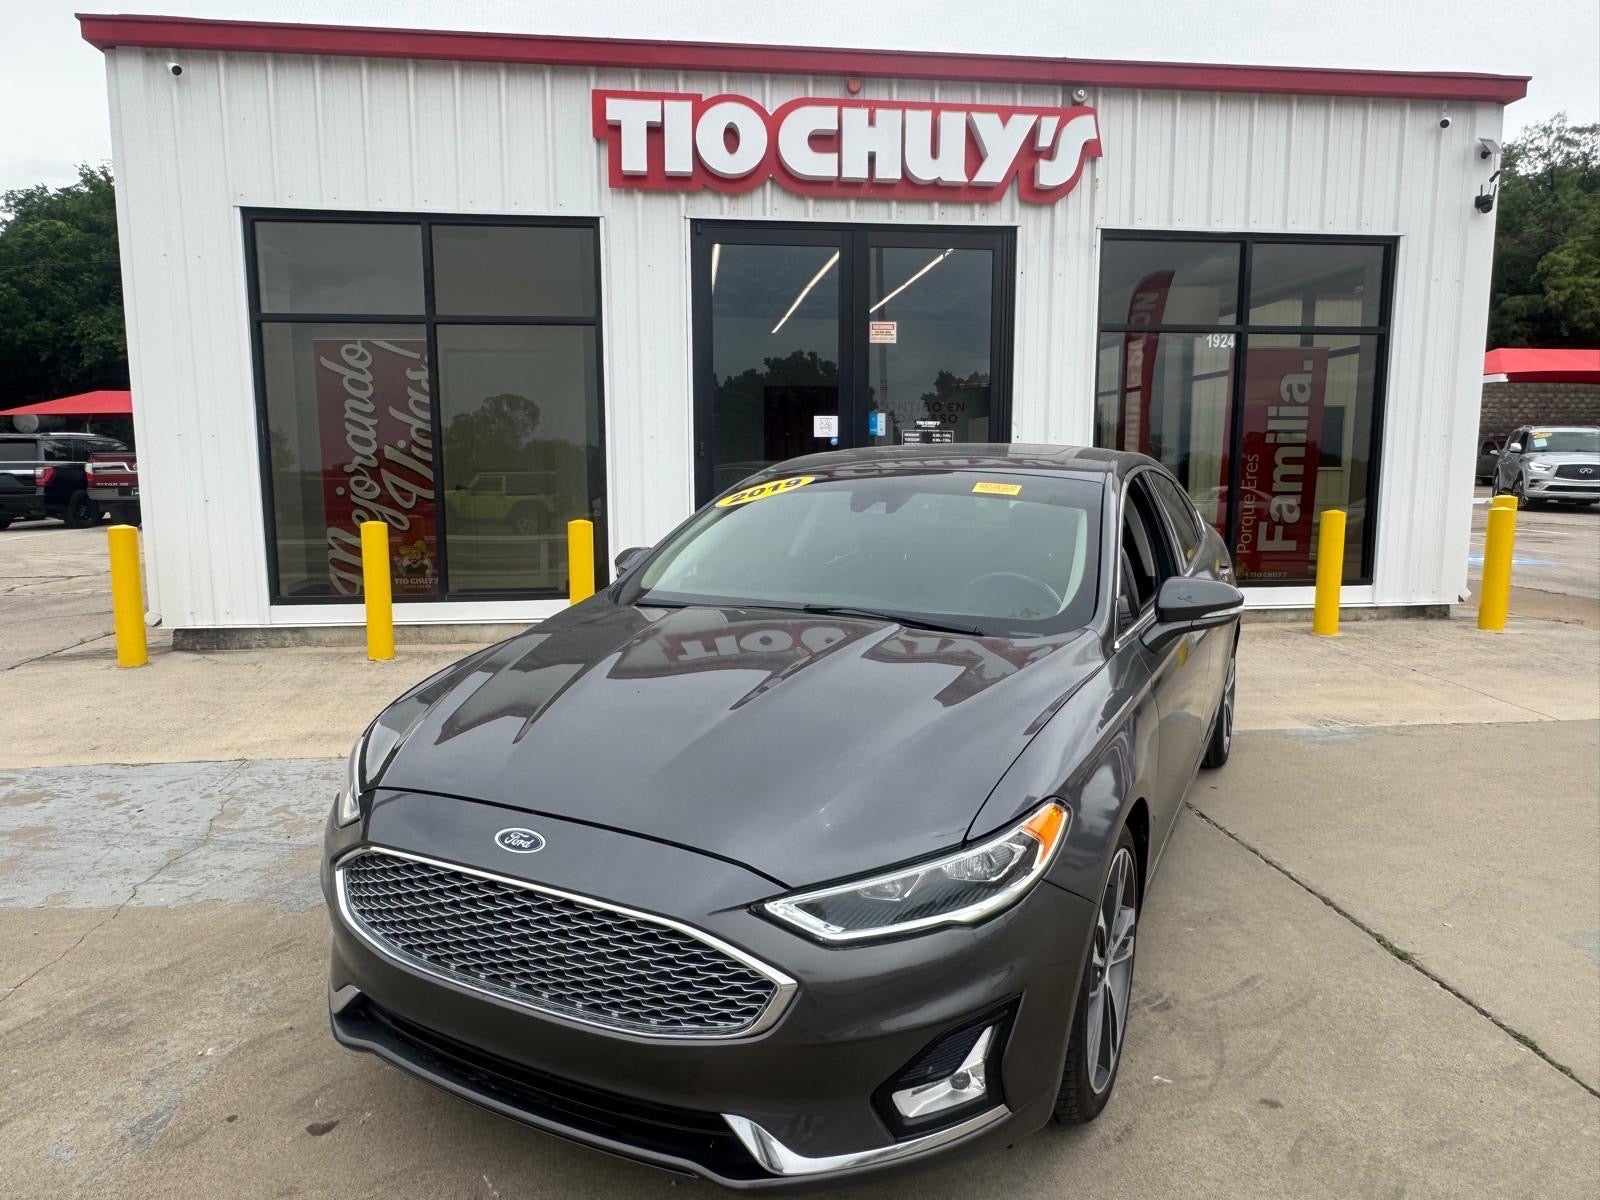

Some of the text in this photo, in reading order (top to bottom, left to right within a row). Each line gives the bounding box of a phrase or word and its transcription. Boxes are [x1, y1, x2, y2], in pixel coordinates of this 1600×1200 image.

[606, 97, 1098, 190] TIO CHUY'S
[1206, 333, 1235, 349] 1924
[947, 402, 965, 412] EN
[320, 340, 410, 595] Mejorando
[1256, 359, 1313, 552] Familia.
[727, 479, 802, 504] 2019
[1236, 453, 1259, 554] Porque Eres
[394, 577, 409, 585] TIO
[504, 832, 535, 848] Ford
